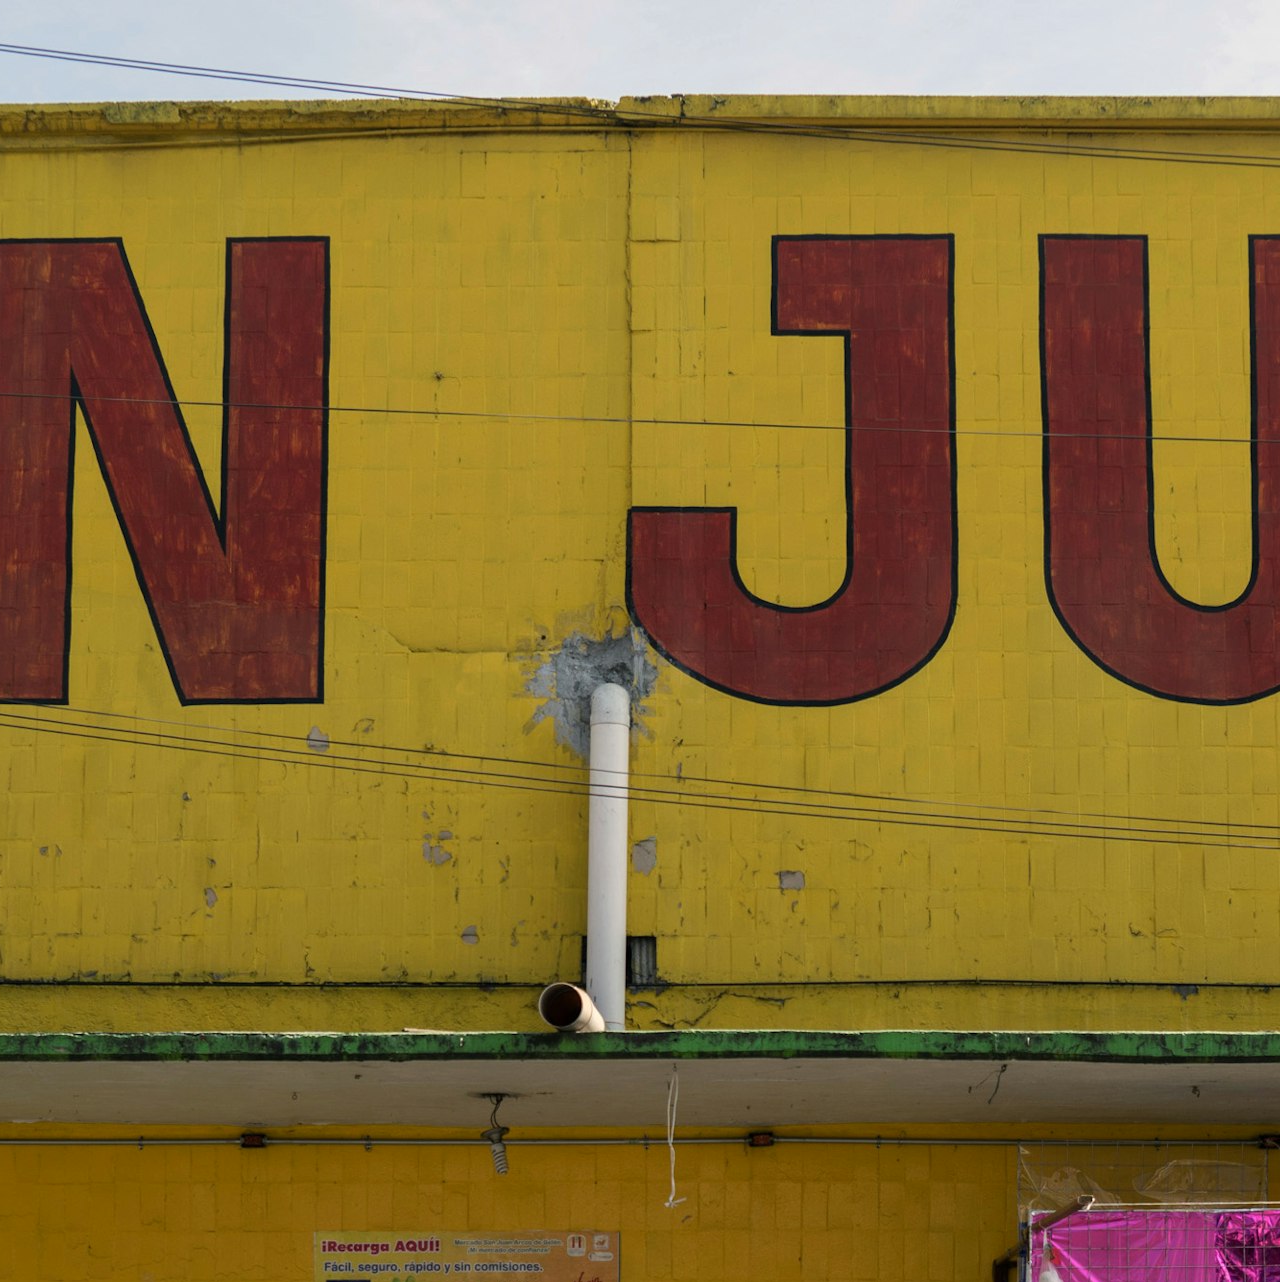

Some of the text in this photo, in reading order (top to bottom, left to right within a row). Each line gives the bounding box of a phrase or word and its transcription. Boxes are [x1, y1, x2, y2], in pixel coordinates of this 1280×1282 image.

[322, 1237, 440, 1254] ¡Recarga AQUÍ!
[324, 1262, 543, 1274] Fácil, seguro, rápido y sin comisiones.
